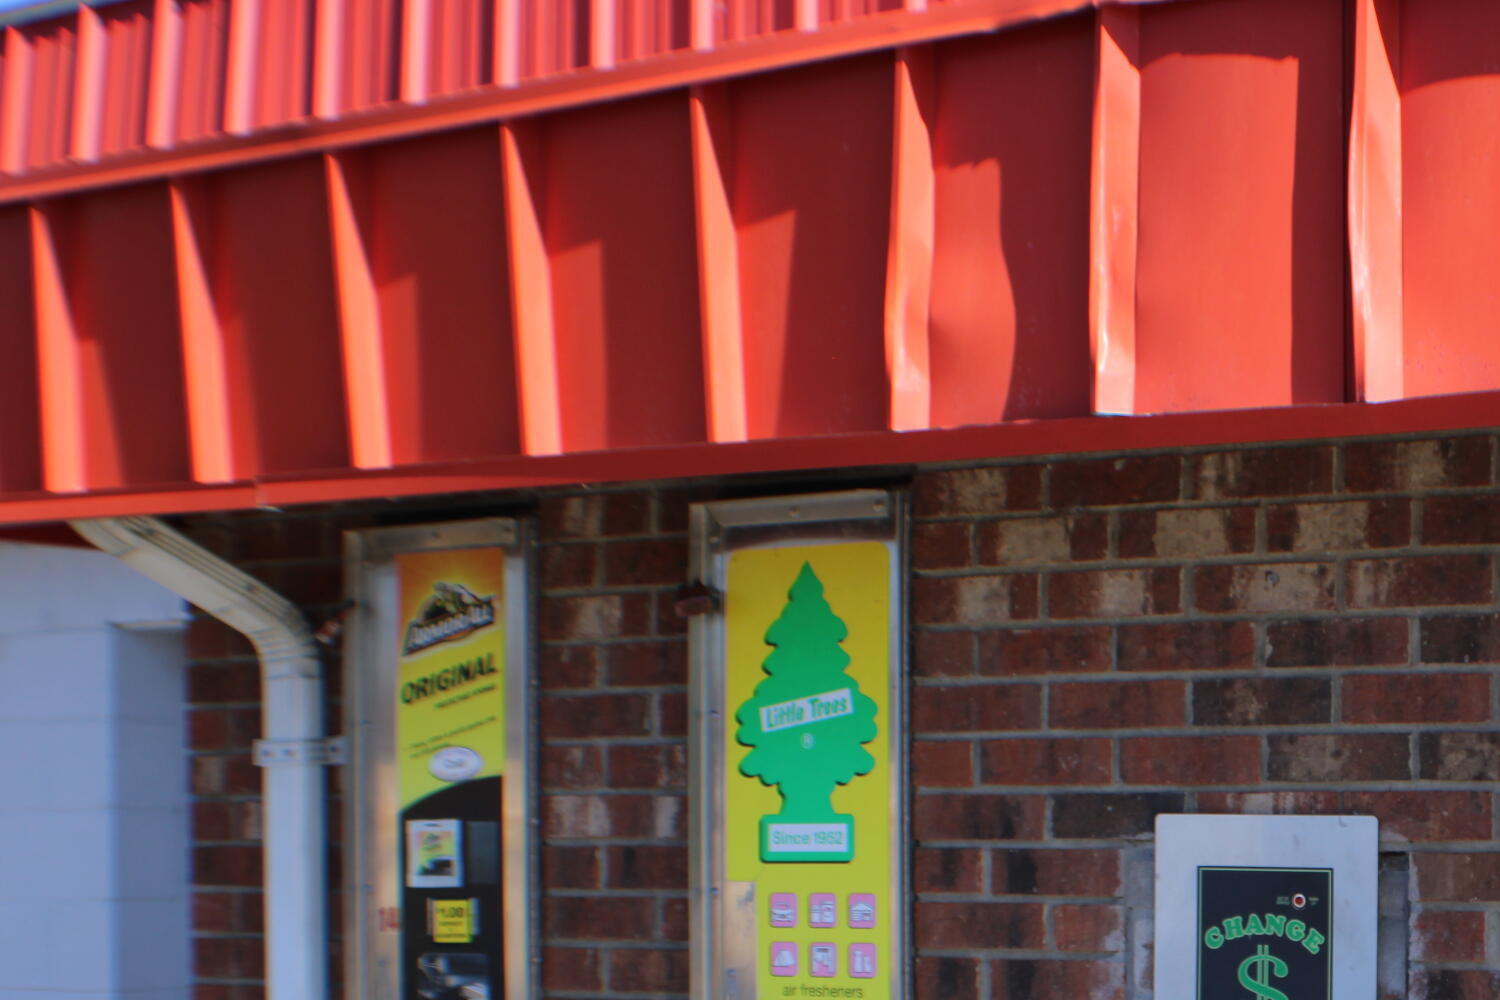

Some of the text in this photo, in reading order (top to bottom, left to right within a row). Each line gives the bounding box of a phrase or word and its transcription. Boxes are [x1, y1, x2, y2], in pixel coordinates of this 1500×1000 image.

[400, 653, 497, 704] ORIGINAL
[765, 698, 848, 728] Little Trees
[773, 831, 844, 845] Since 1952
[1204, 913, 1326, 954] CHANGE
[782, 984, 864, 998] air fresheners
